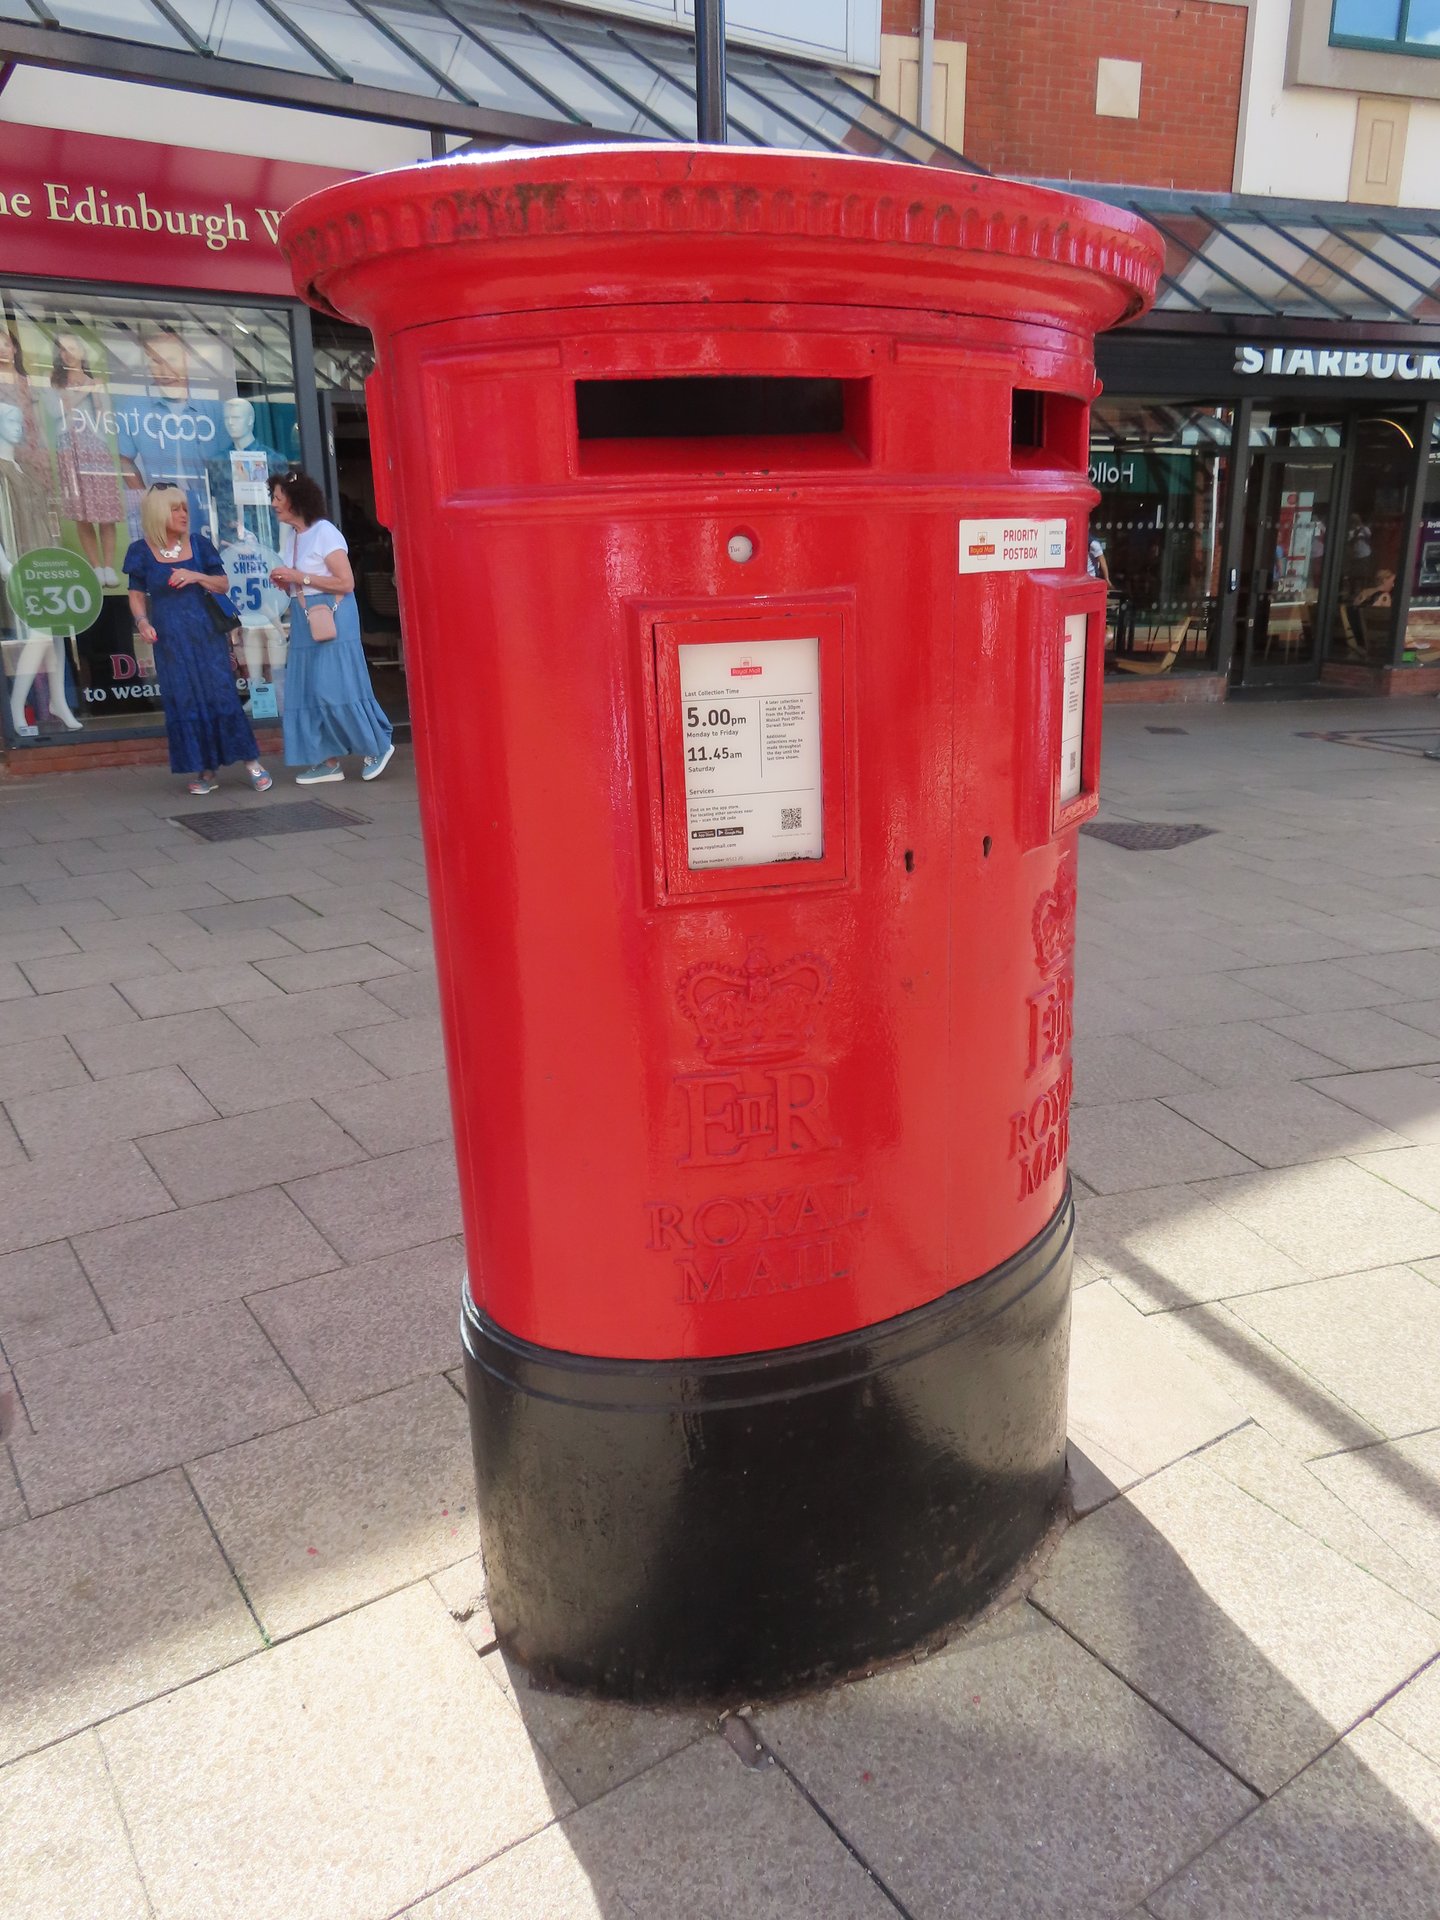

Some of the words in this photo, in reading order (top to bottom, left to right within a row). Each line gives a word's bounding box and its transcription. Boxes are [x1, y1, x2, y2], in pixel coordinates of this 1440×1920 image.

[43, 182, 250, 251] Edinburgh
[1003, 529, 1038, 542] PRIORITY
[970, 546, 984, 555] Royal
[1003, 548, 1038, 560] POSTBOX
[25, 569, 80, 580] Dresses
[233, 561, 269, 575] SHIRTS
[25, 585, 92, 616] £30
[230, 577, 262, 611] £5
[83, 686, 107, 703] to
[688, 707, 746, 728] 5.00pm
[688, 746, 742, 762] 11.45am
[646, 1176, 869, 1251] ROYAL
[673, 1240, 850, 1305] MAIL
